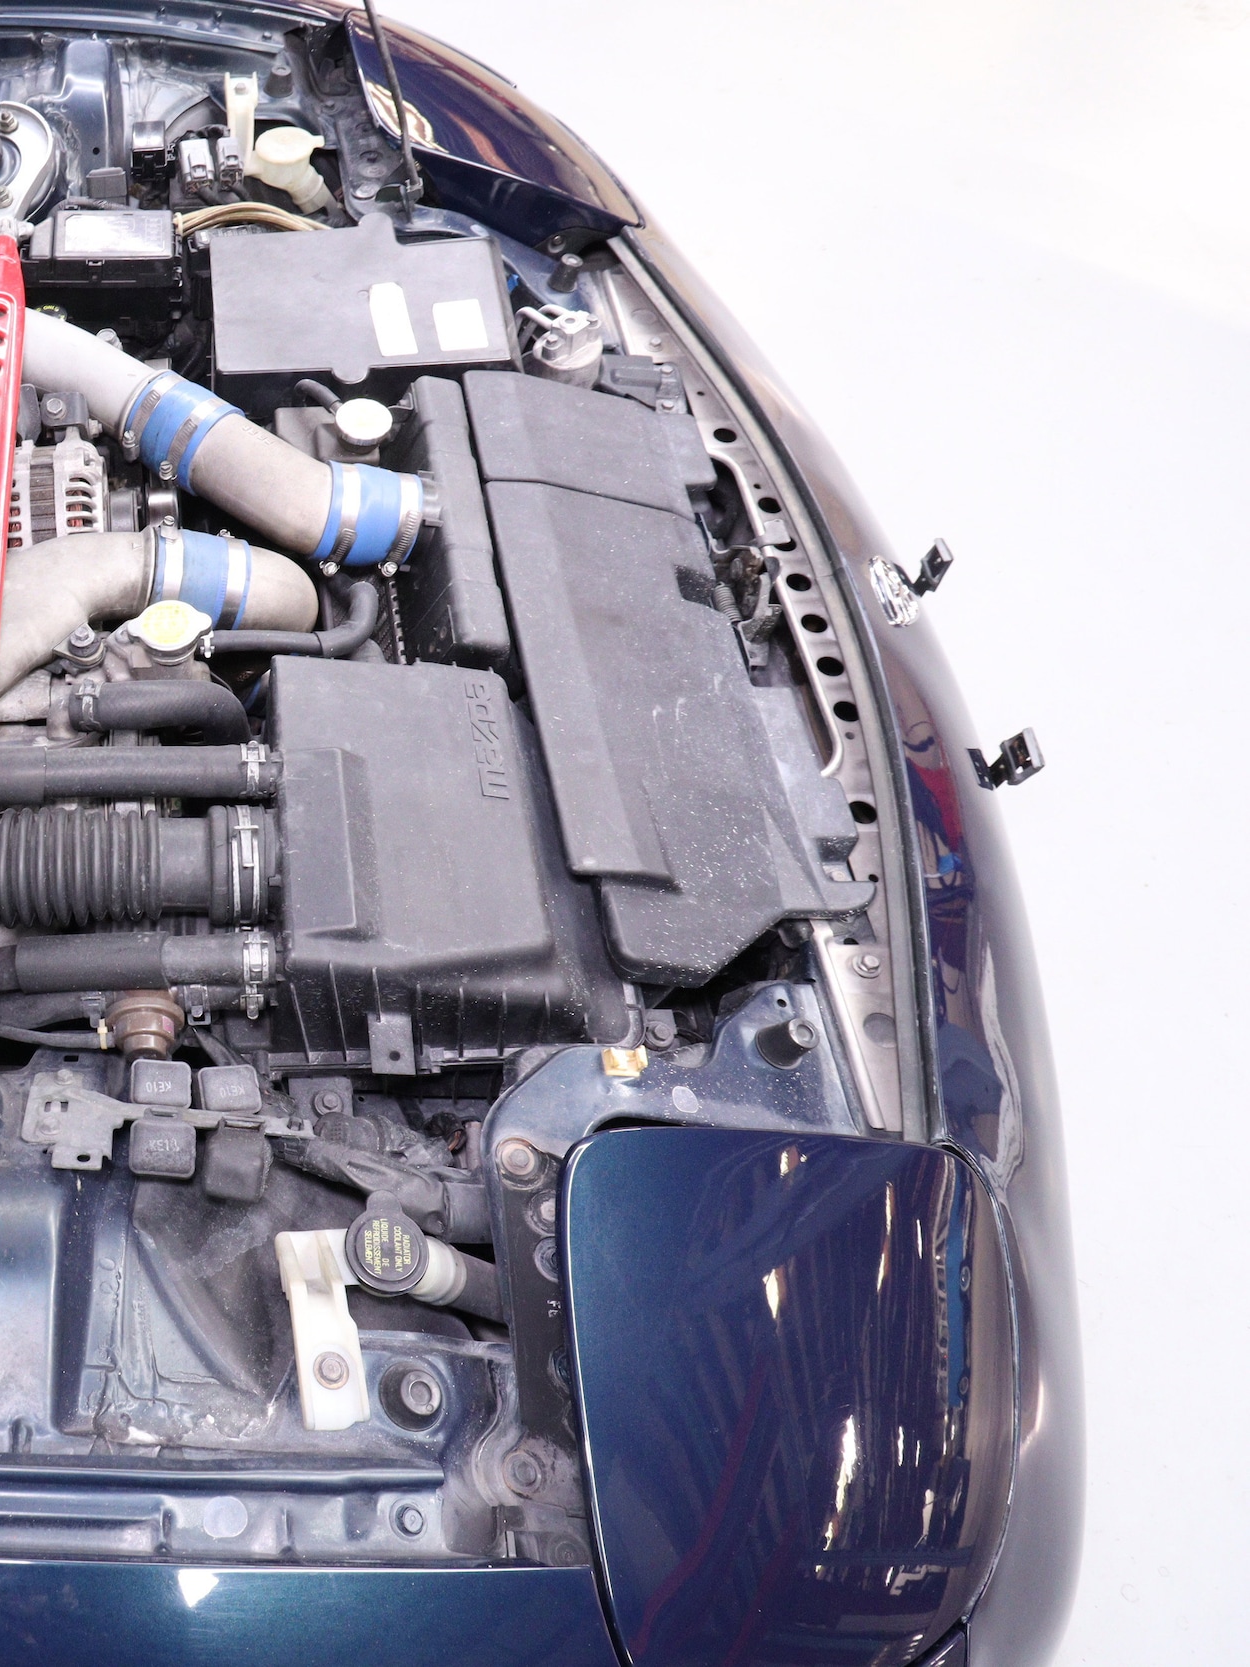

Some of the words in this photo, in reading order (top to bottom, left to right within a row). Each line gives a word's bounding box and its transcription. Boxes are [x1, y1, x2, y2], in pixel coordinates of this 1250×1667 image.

[145, 1081, 172, 1093] KE10
[219, 1085, 246, 1098] KE10
[380, 1218, 389, 1243] LIQUIDE
[393, 1225, 403, 1255] COOLANT
[402, 1234, 412, 1265] RADIATOR
[381, 1257, 390, 1267] DE
[394, 1255, 403, 1273] ONLY
